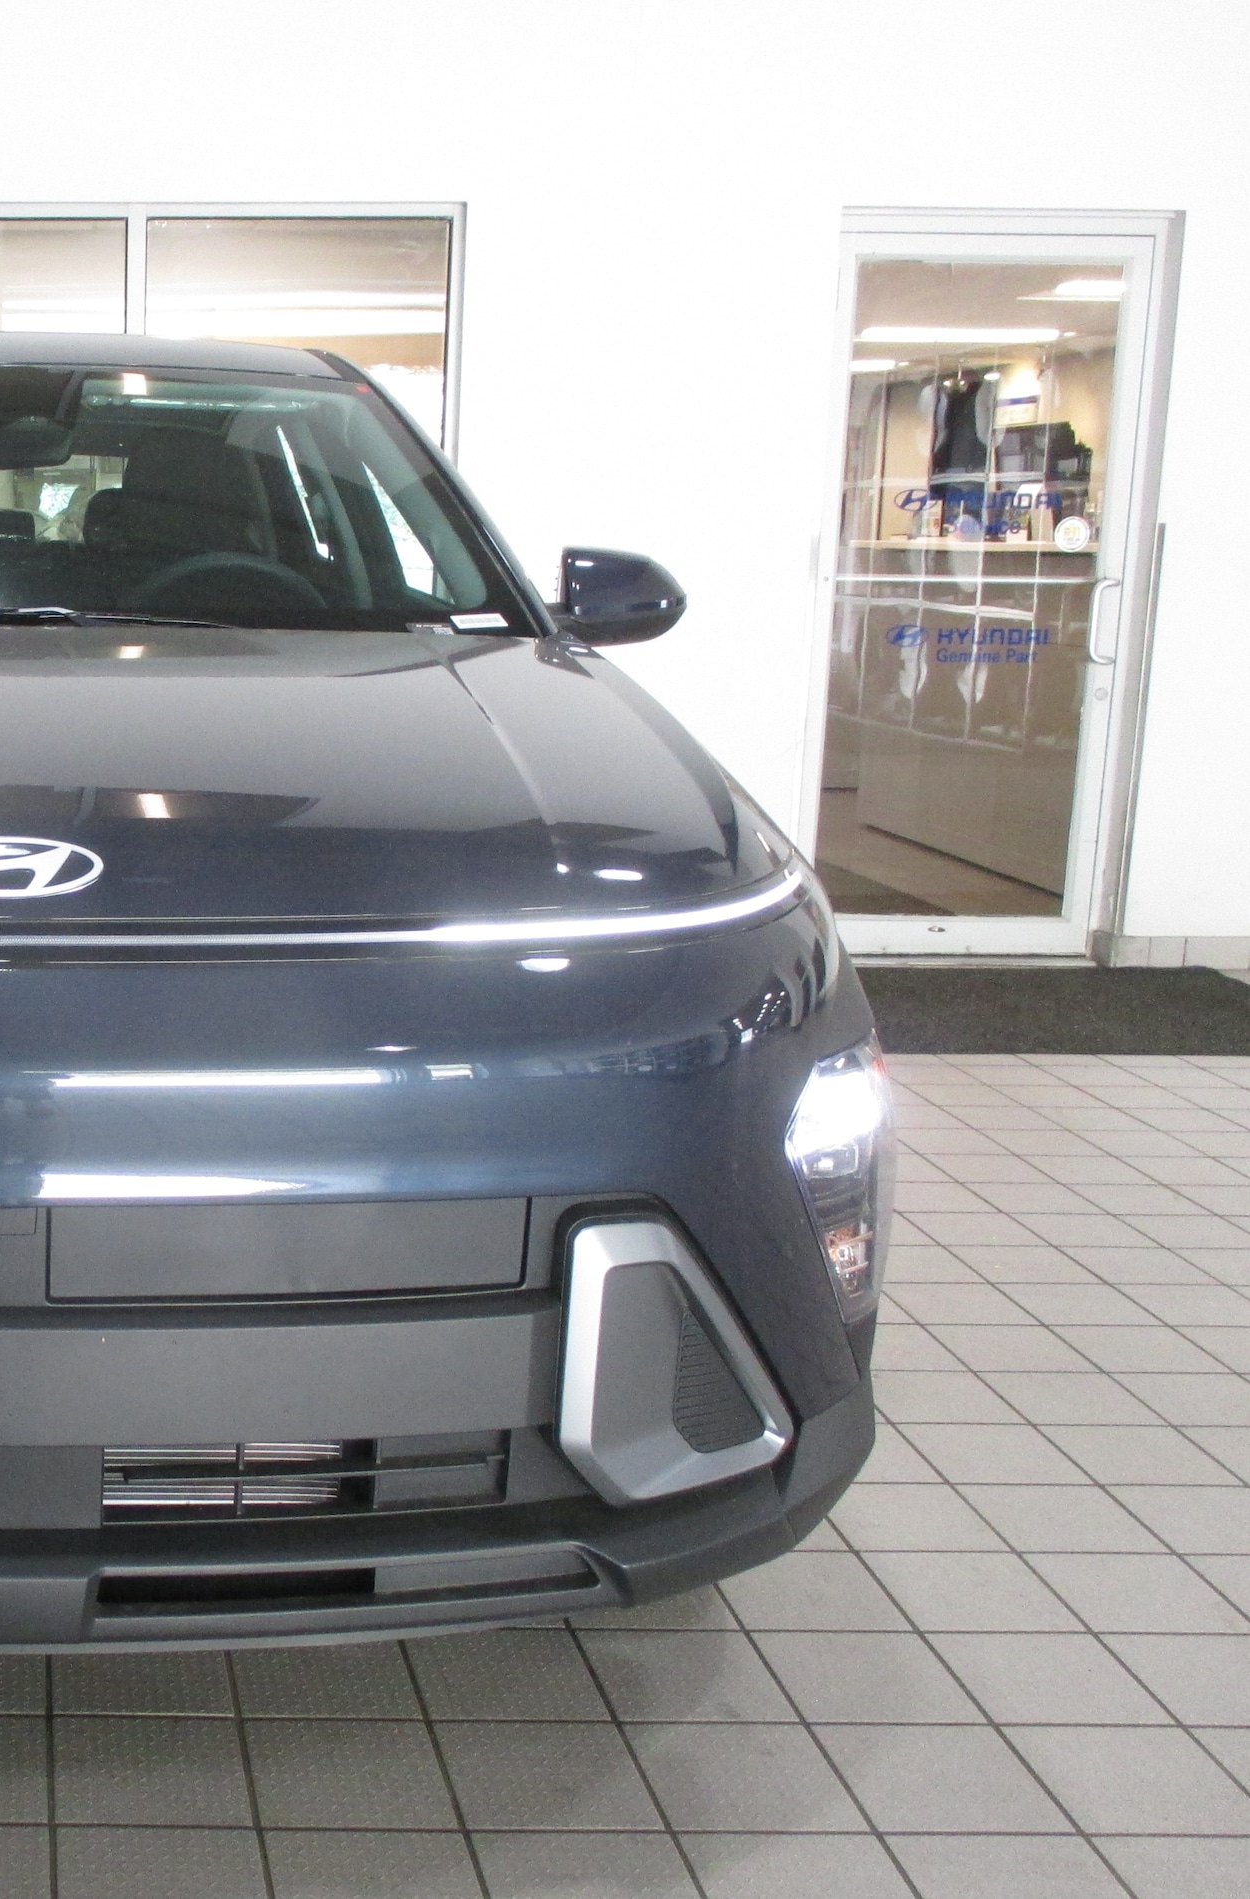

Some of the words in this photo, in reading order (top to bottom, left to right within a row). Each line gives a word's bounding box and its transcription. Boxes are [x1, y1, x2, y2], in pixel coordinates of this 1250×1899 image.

[944, 514, 1021, 534] Sice
[937, 628, 1050, 645] HYUNDAI
[936, 648, 1000, 663] Genuine
